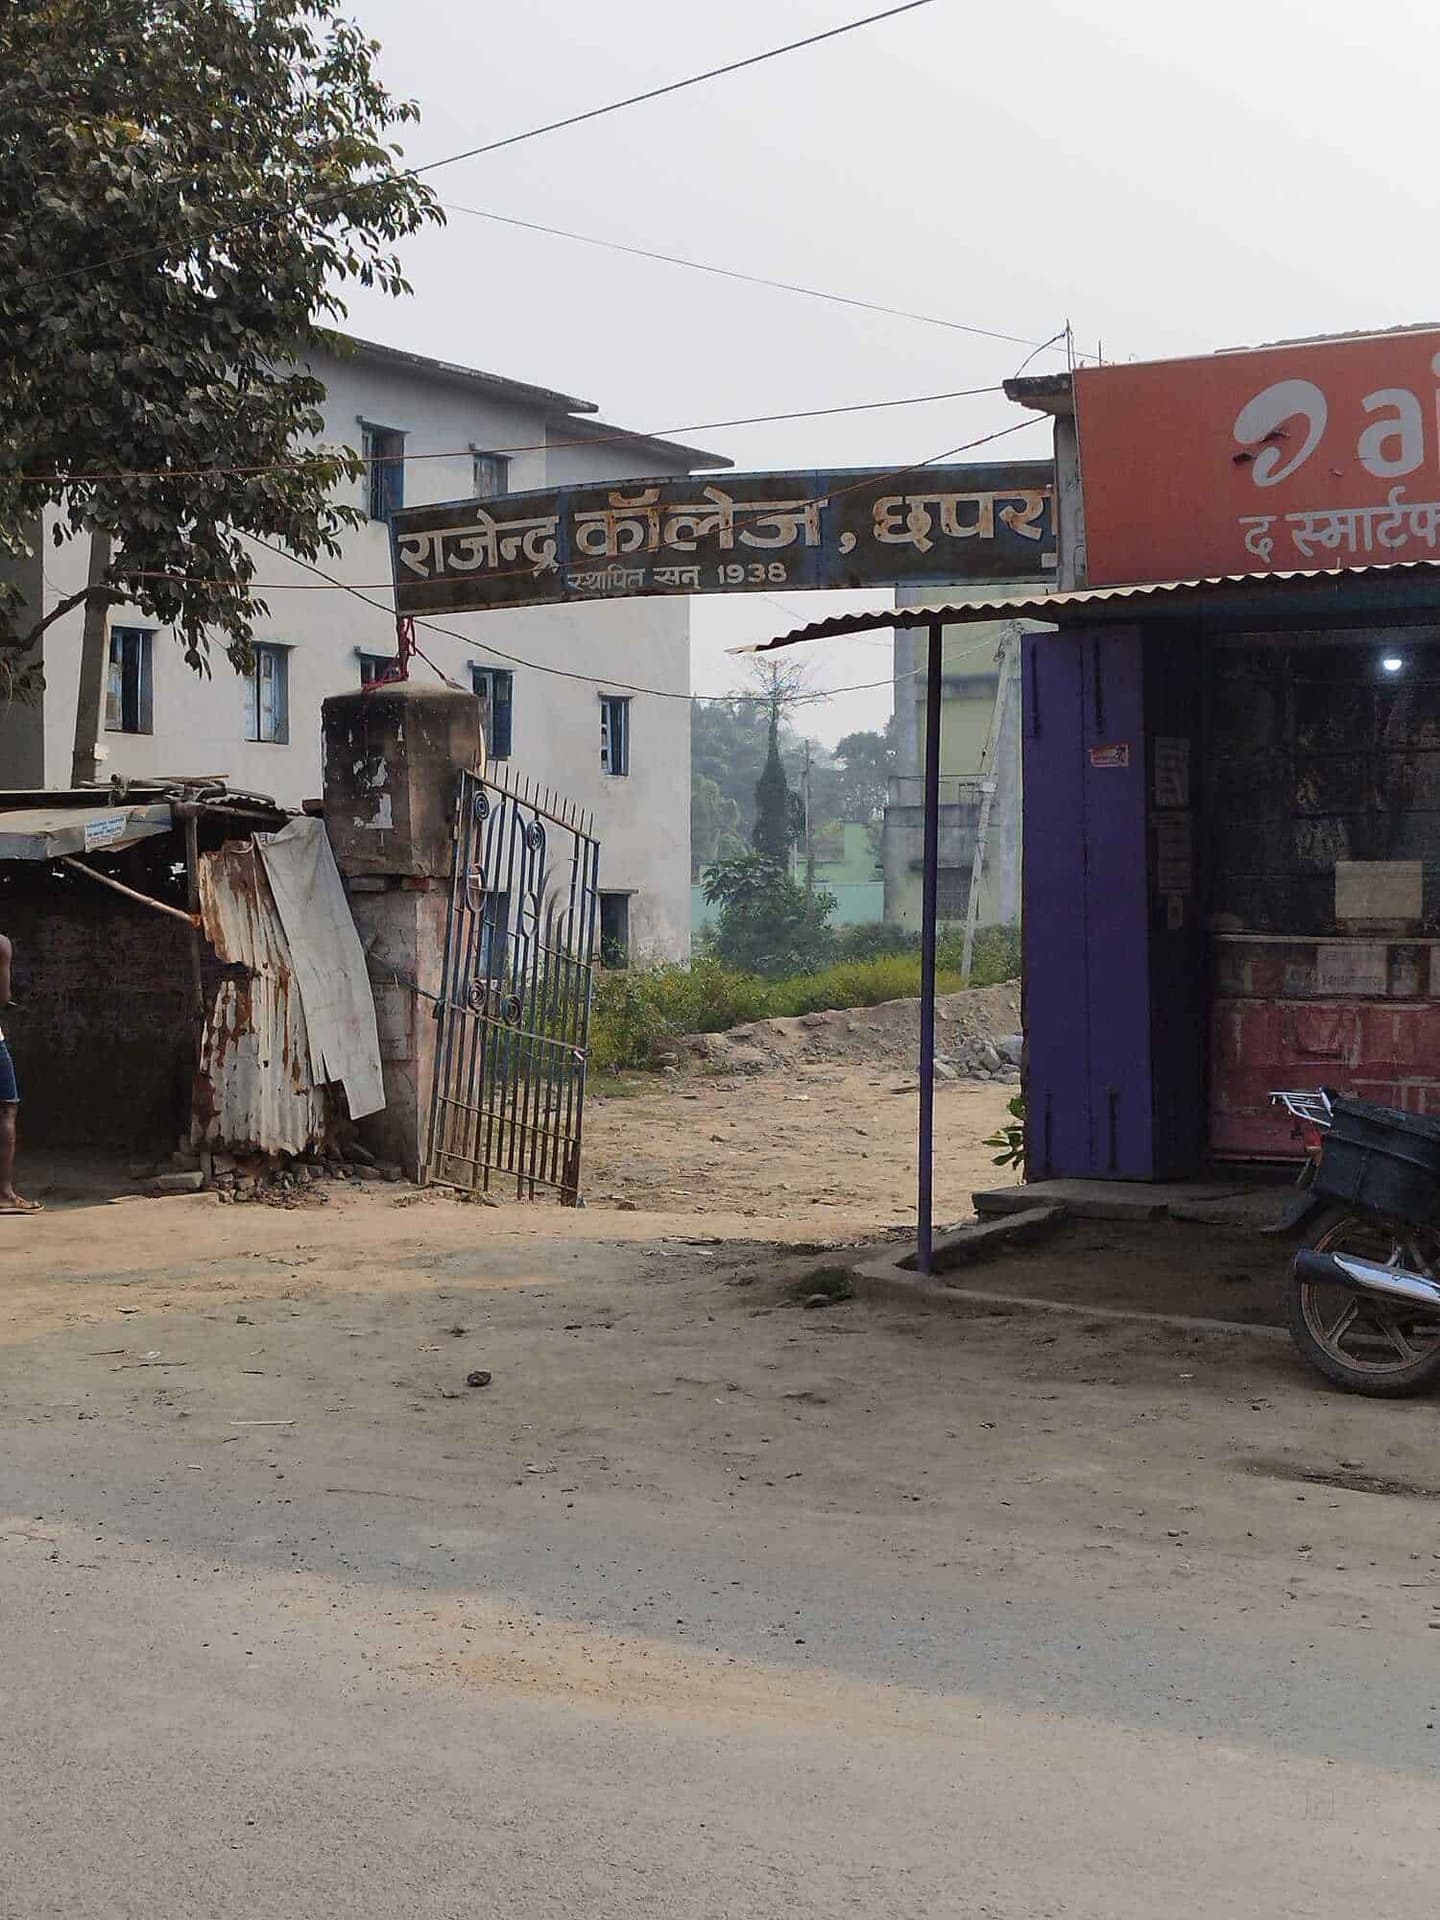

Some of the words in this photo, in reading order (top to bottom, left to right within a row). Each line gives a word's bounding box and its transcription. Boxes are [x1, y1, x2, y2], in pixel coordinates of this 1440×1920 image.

[398, 508, 559, 577] राजेन्द्र
[1239, 515, 1277, 563] द
[567, 563, 646, 591] स्थापित
[717, 562, 787, 584] 1938
